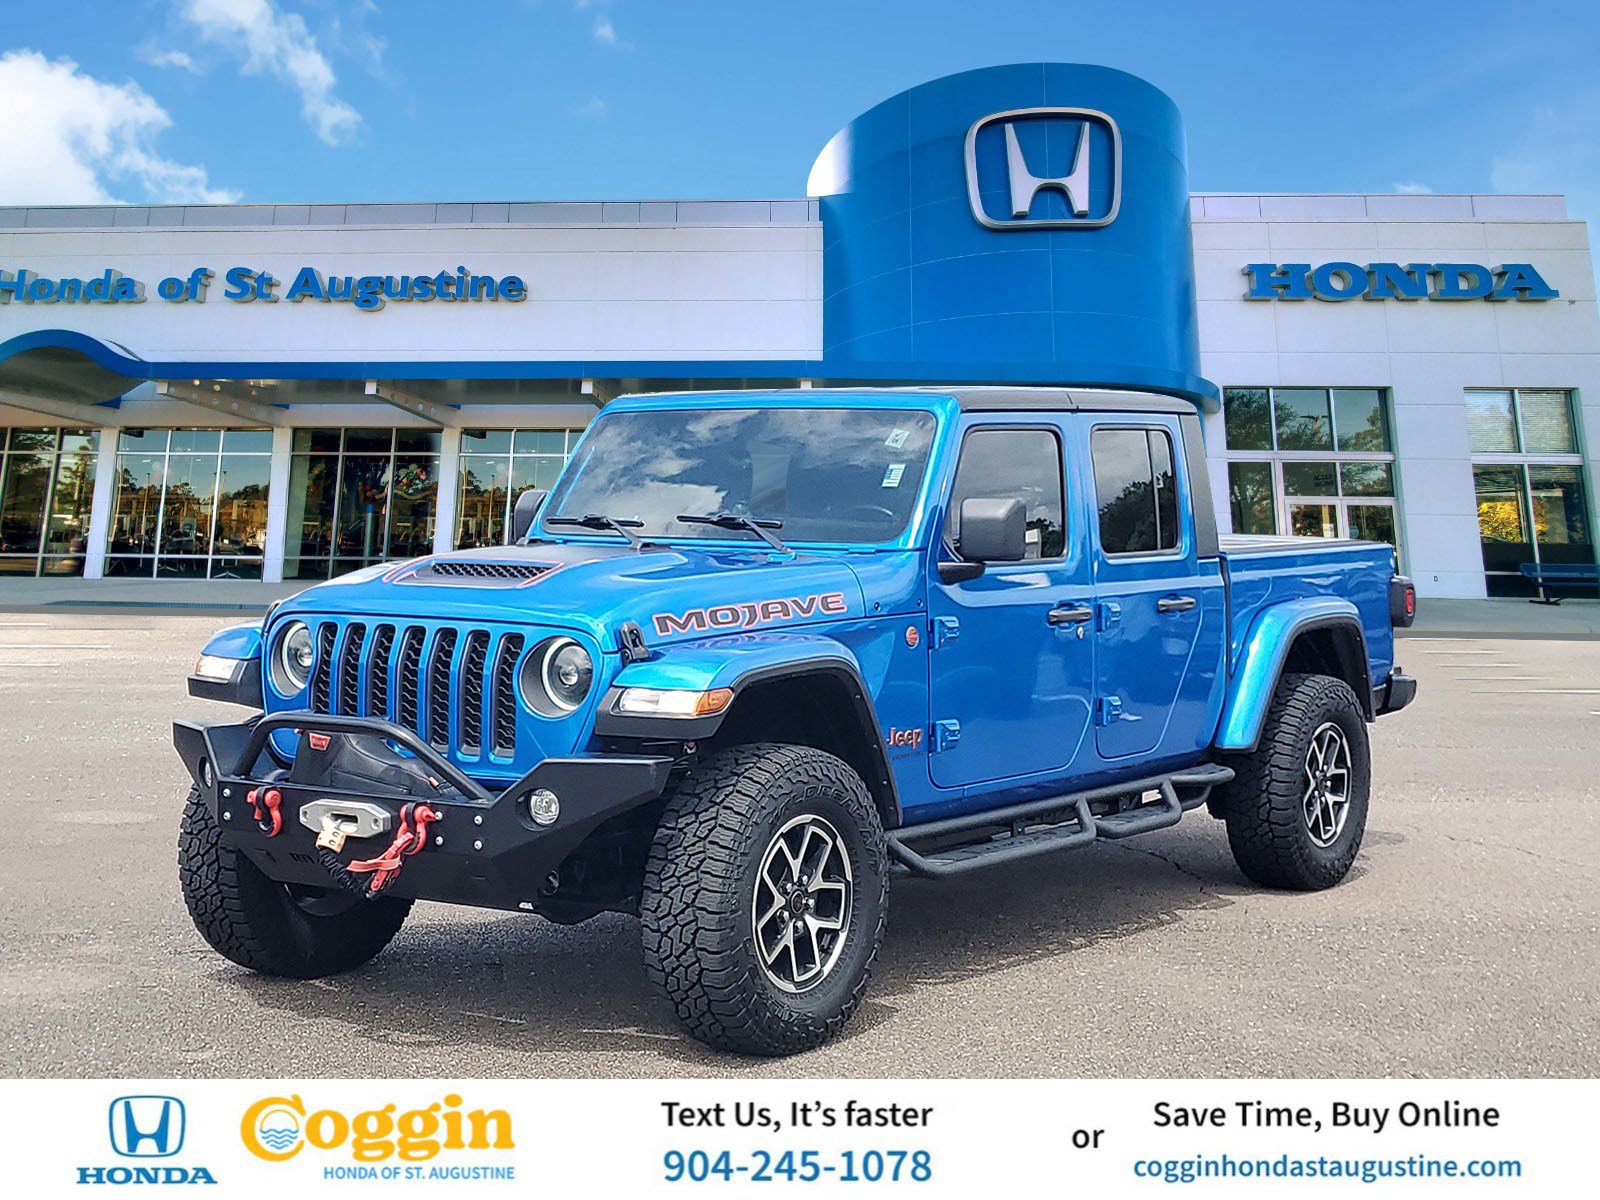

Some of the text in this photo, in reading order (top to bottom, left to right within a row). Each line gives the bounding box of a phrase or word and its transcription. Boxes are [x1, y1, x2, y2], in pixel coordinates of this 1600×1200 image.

[0, 265, 526, 311] Honda of St Augustine
[1244, 262, 1560, 301] HONDA
[652, 592, 847, 636] MOJAVE
[886, 726, 922, 750] Jeep
